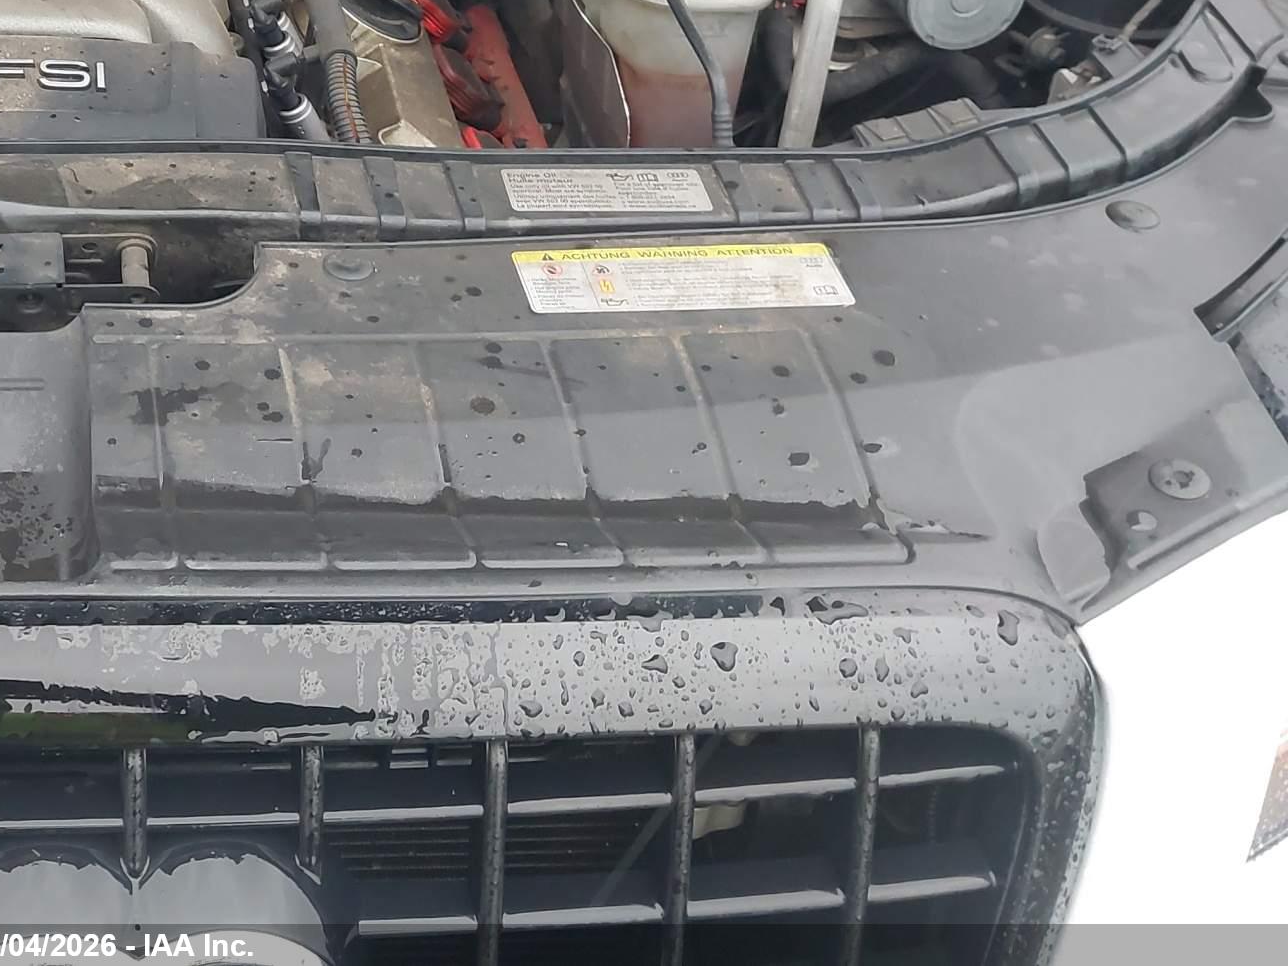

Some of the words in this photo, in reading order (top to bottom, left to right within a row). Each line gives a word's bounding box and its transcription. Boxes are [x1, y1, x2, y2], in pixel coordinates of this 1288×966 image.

[561, 251, 631, 261] ACHTUNG
[637, 249, 709, 259] WARNING
[716, 246, 794, 256] ATTENTION
